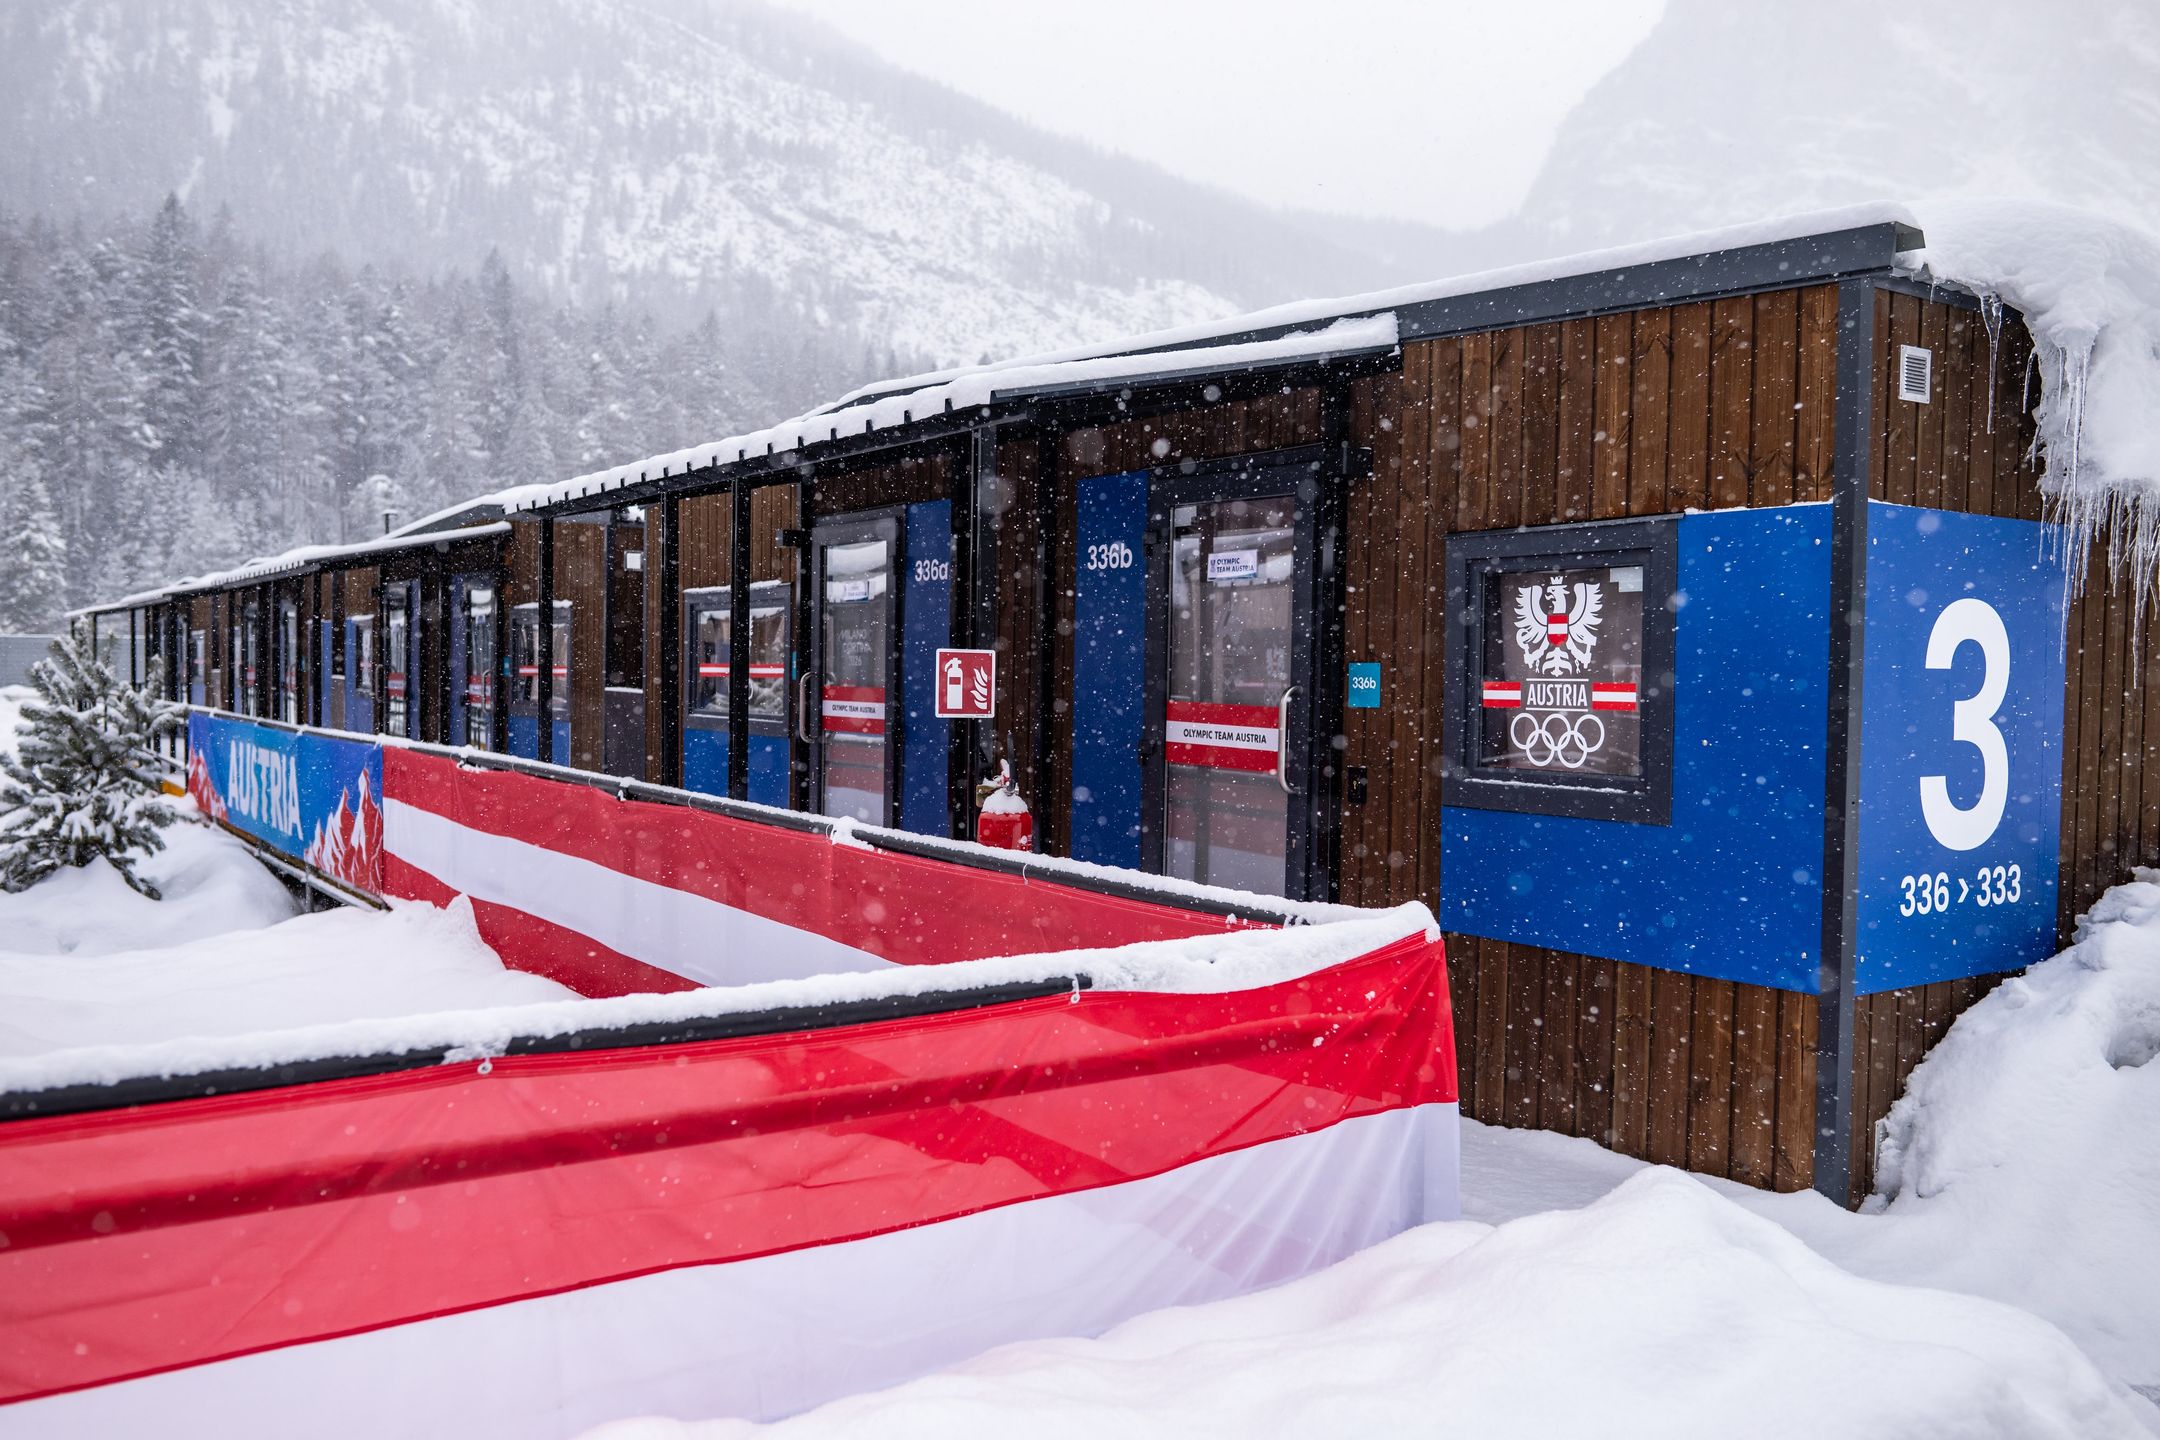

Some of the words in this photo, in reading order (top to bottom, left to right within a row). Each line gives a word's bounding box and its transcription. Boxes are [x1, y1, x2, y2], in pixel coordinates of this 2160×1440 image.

[1087, 543, 1133, 570] 336b
[1216, 557, 1240, 566] OLYMPIC
[915, 559, 949, 582] 336a
[1216, 565, 1231, 573] TEAM
[1231, 564, 1255, 573] AUSTRIA
[1352, 677, 1377, 689] 336b
[1526, 683, 1588, 707] AUSTRIA
[831, 704, 848, 712] OLYMPIC
[848, 705, 859, 713] TEAM
[1183, 728, 1213, 740] OLYMPIC
[1214, 731, 1234, 741] TEAM
[1235, 733, 1267, 744] AUSTRIA
[1919, 598, 2011, 851] 3
[227, 739, 304, 841] AUSTRIA
[1900, 872, 1950, 917] 336
[1976, 864, 2021, 907] 333
